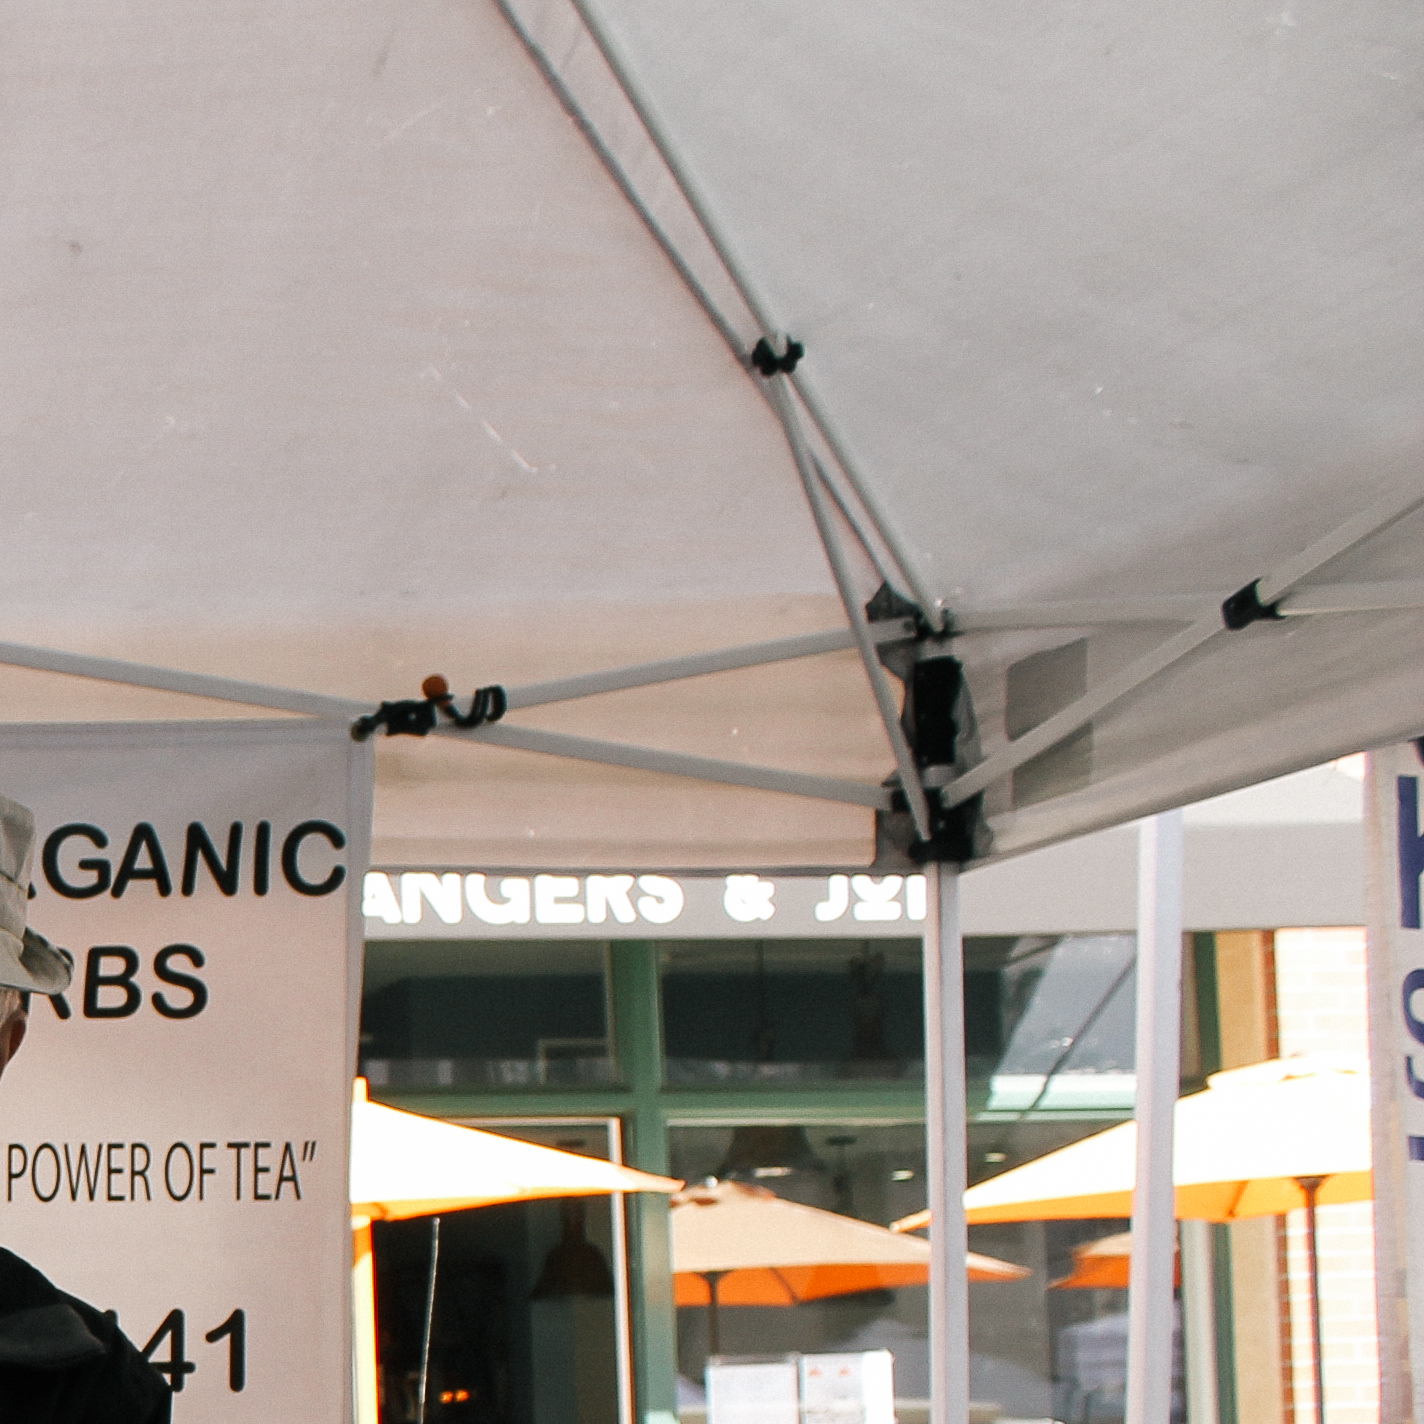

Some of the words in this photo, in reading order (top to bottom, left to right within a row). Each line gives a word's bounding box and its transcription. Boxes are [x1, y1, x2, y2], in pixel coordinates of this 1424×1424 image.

[28, 819, 347, 899] GANIC
[723, 874, 775, 921] &
[7, 1142, 152, 1202] POWER
[164, 1142, 218, 1202] OF
[138, 1308, 246, 1393] 41
